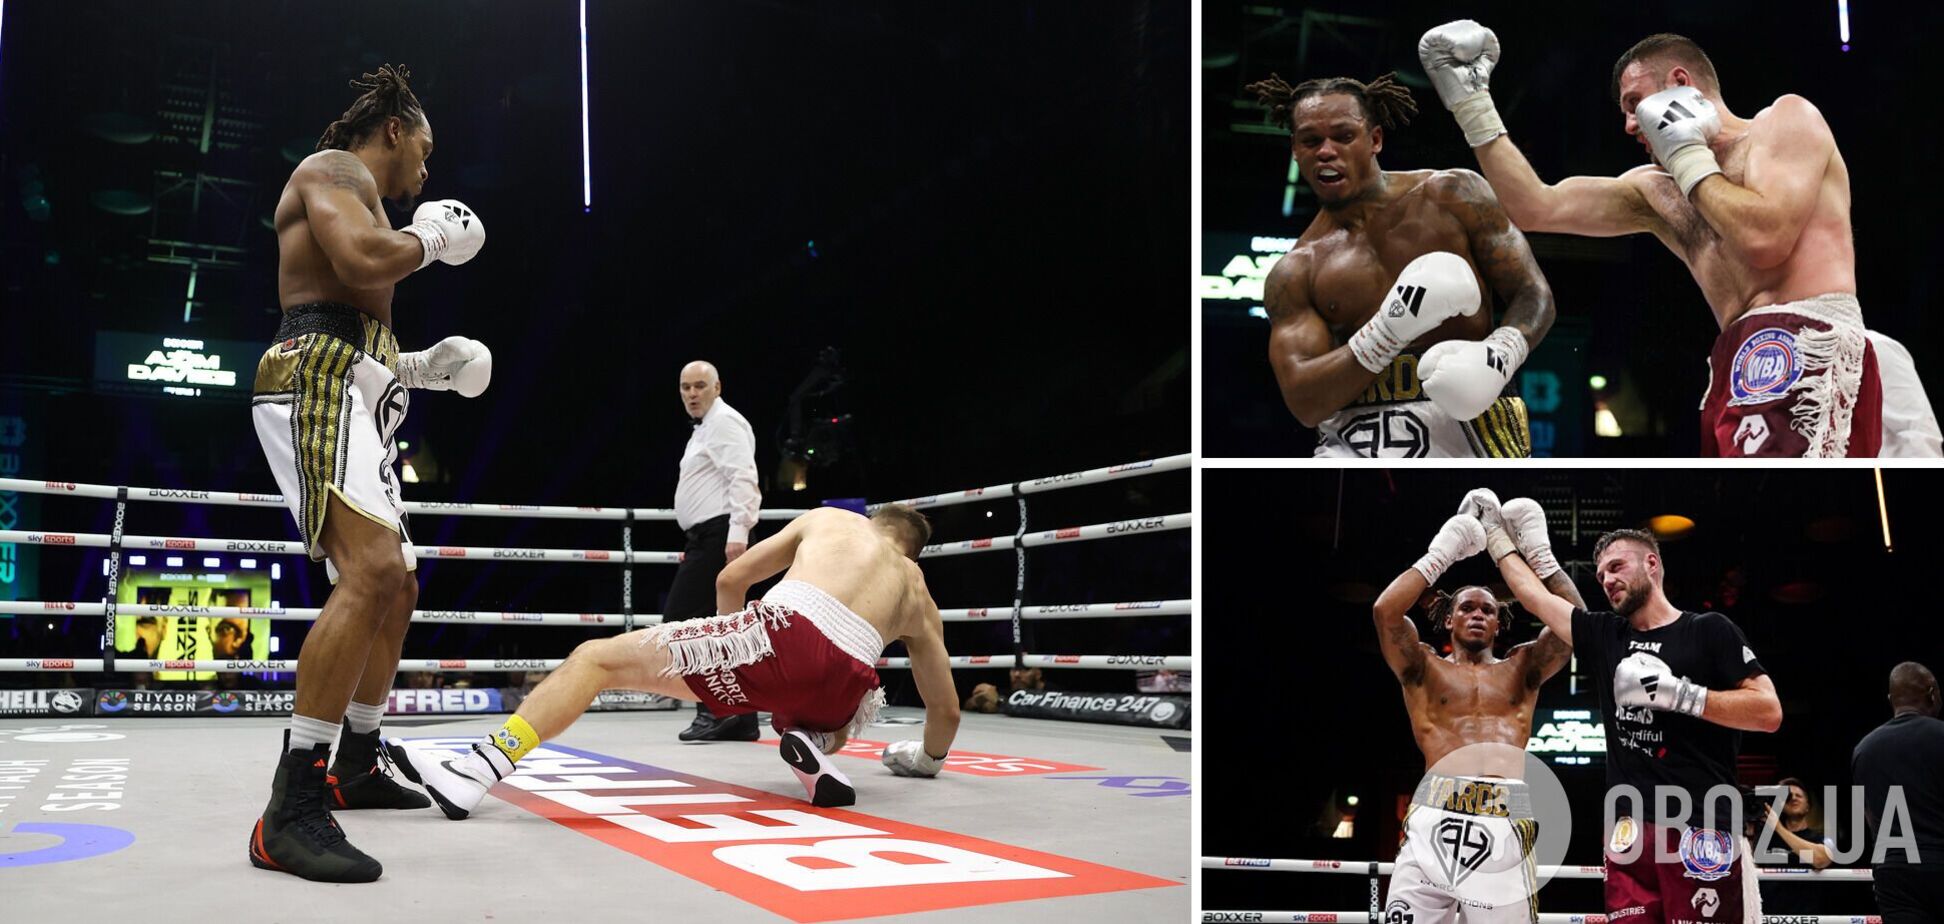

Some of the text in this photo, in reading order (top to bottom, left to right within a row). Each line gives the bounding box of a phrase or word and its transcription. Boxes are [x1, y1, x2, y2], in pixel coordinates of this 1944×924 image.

[1747, 354, 1786, 385] WBA
[149, 489, 209, 499] BOXXER
[113, 502, 125, 544] BOXXER
[1106, 517, 1165, 534] BOXXER
[28, 534, 75, 544] sky sports
[150, 540, 195, 549] sky sports
[226, 542, 286, 552] BOXXER
[494, 549, 545, 558] BOXXER
[108, 552, 119, 595] BOXXER
[106, 603, 115, 646] BOXXER
[1628, 640, 1663, 653] TEAM
[42, 660, 74, 669] sports
[227, 661, 286, 669] BOXXER
[0, 691, 48, 709] HELL
[134, 693, 196, 702] RIYADH
[245, 693, 294, 702] RIYAD
[133, 703, 196, 711] SEASON
[245, 703, 294, 712] SEASO
[1116, 696, 1160, 713] 247
[40, 758, 131, 812] SEASON
[1427, 775, 1510, 818] YARDE
[1371, 878, 1379, 920] BOXXER
[1204, 913, 1337, 923] BOXXER sky sports
[1570, 916, 1583, 924] sky
